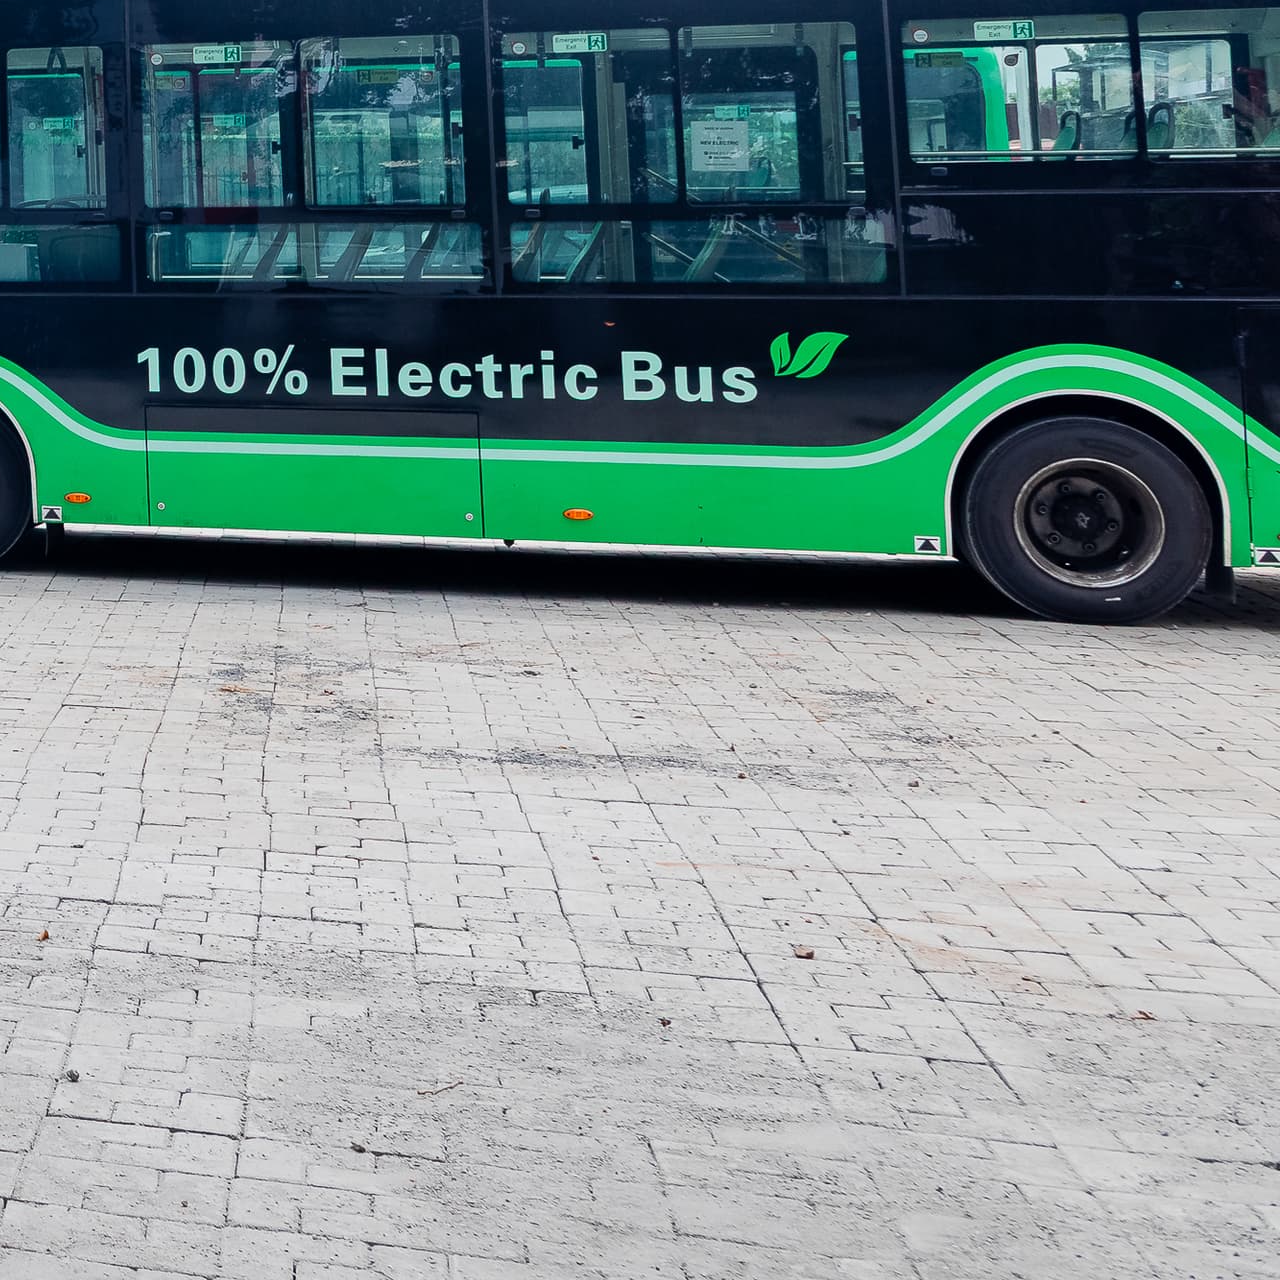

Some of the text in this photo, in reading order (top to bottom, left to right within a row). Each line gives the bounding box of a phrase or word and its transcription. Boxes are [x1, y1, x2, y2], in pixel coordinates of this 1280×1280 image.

[555, 36, 587, 44] Emergency
[138, 345, 757, 402] 100% Electric Bus
